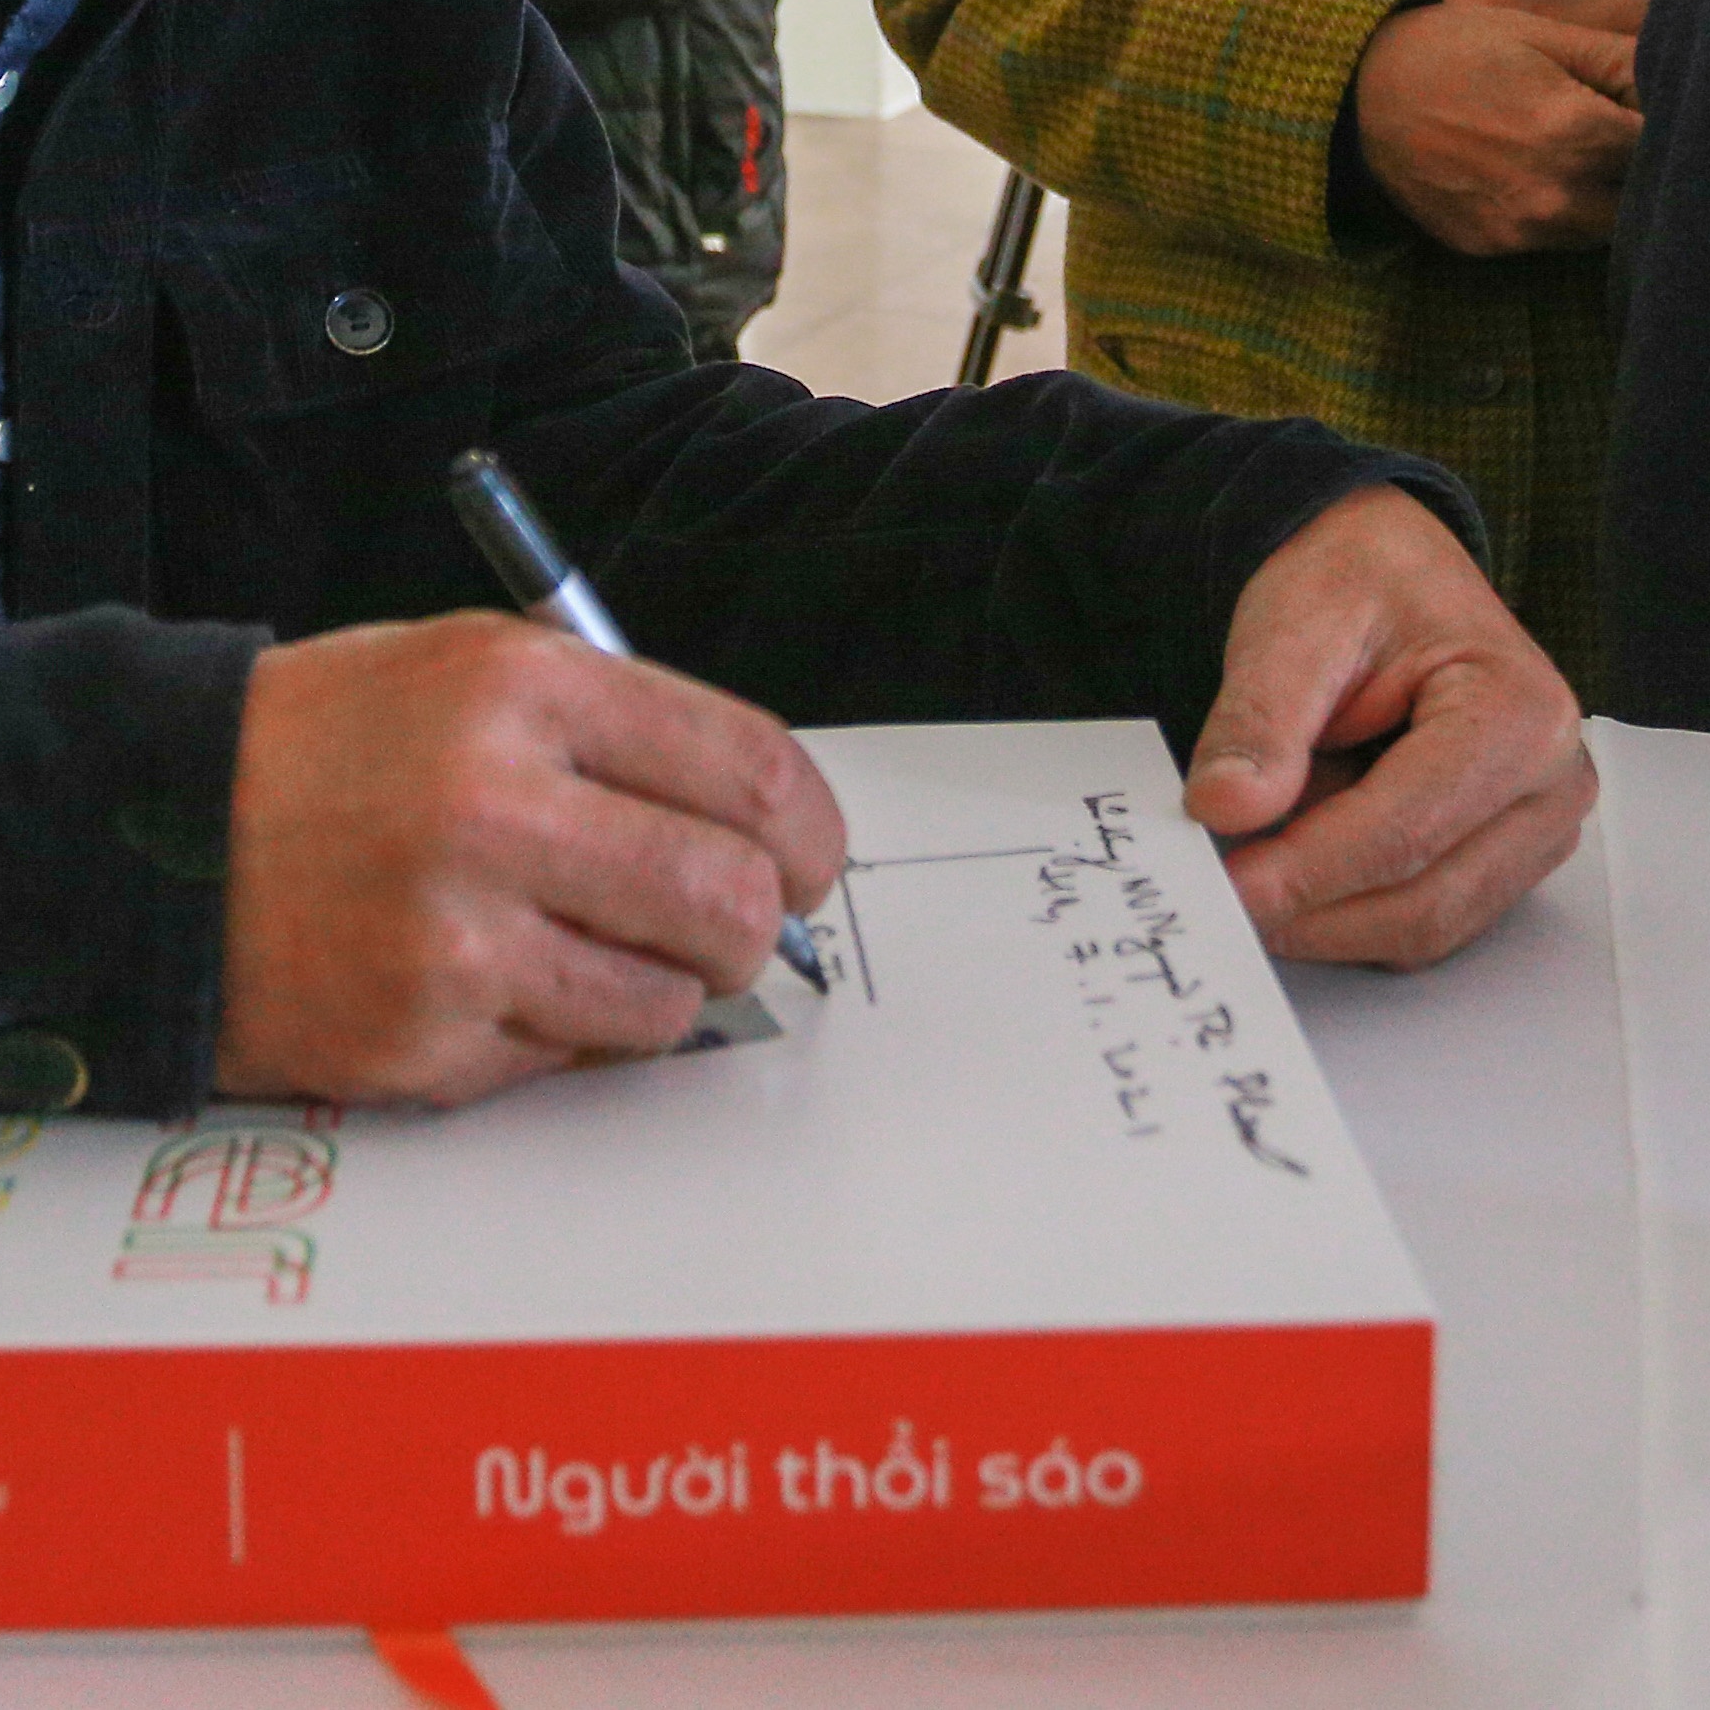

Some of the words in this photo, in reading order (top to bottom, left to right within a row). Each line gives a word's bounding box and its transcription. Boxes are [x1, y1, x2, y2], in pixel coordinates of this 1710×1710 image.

[473, 1440, 750, 1536] Người
[774, 1417, 951, 1511] thổi
[977, 1436, 1144, 1510] sáo
